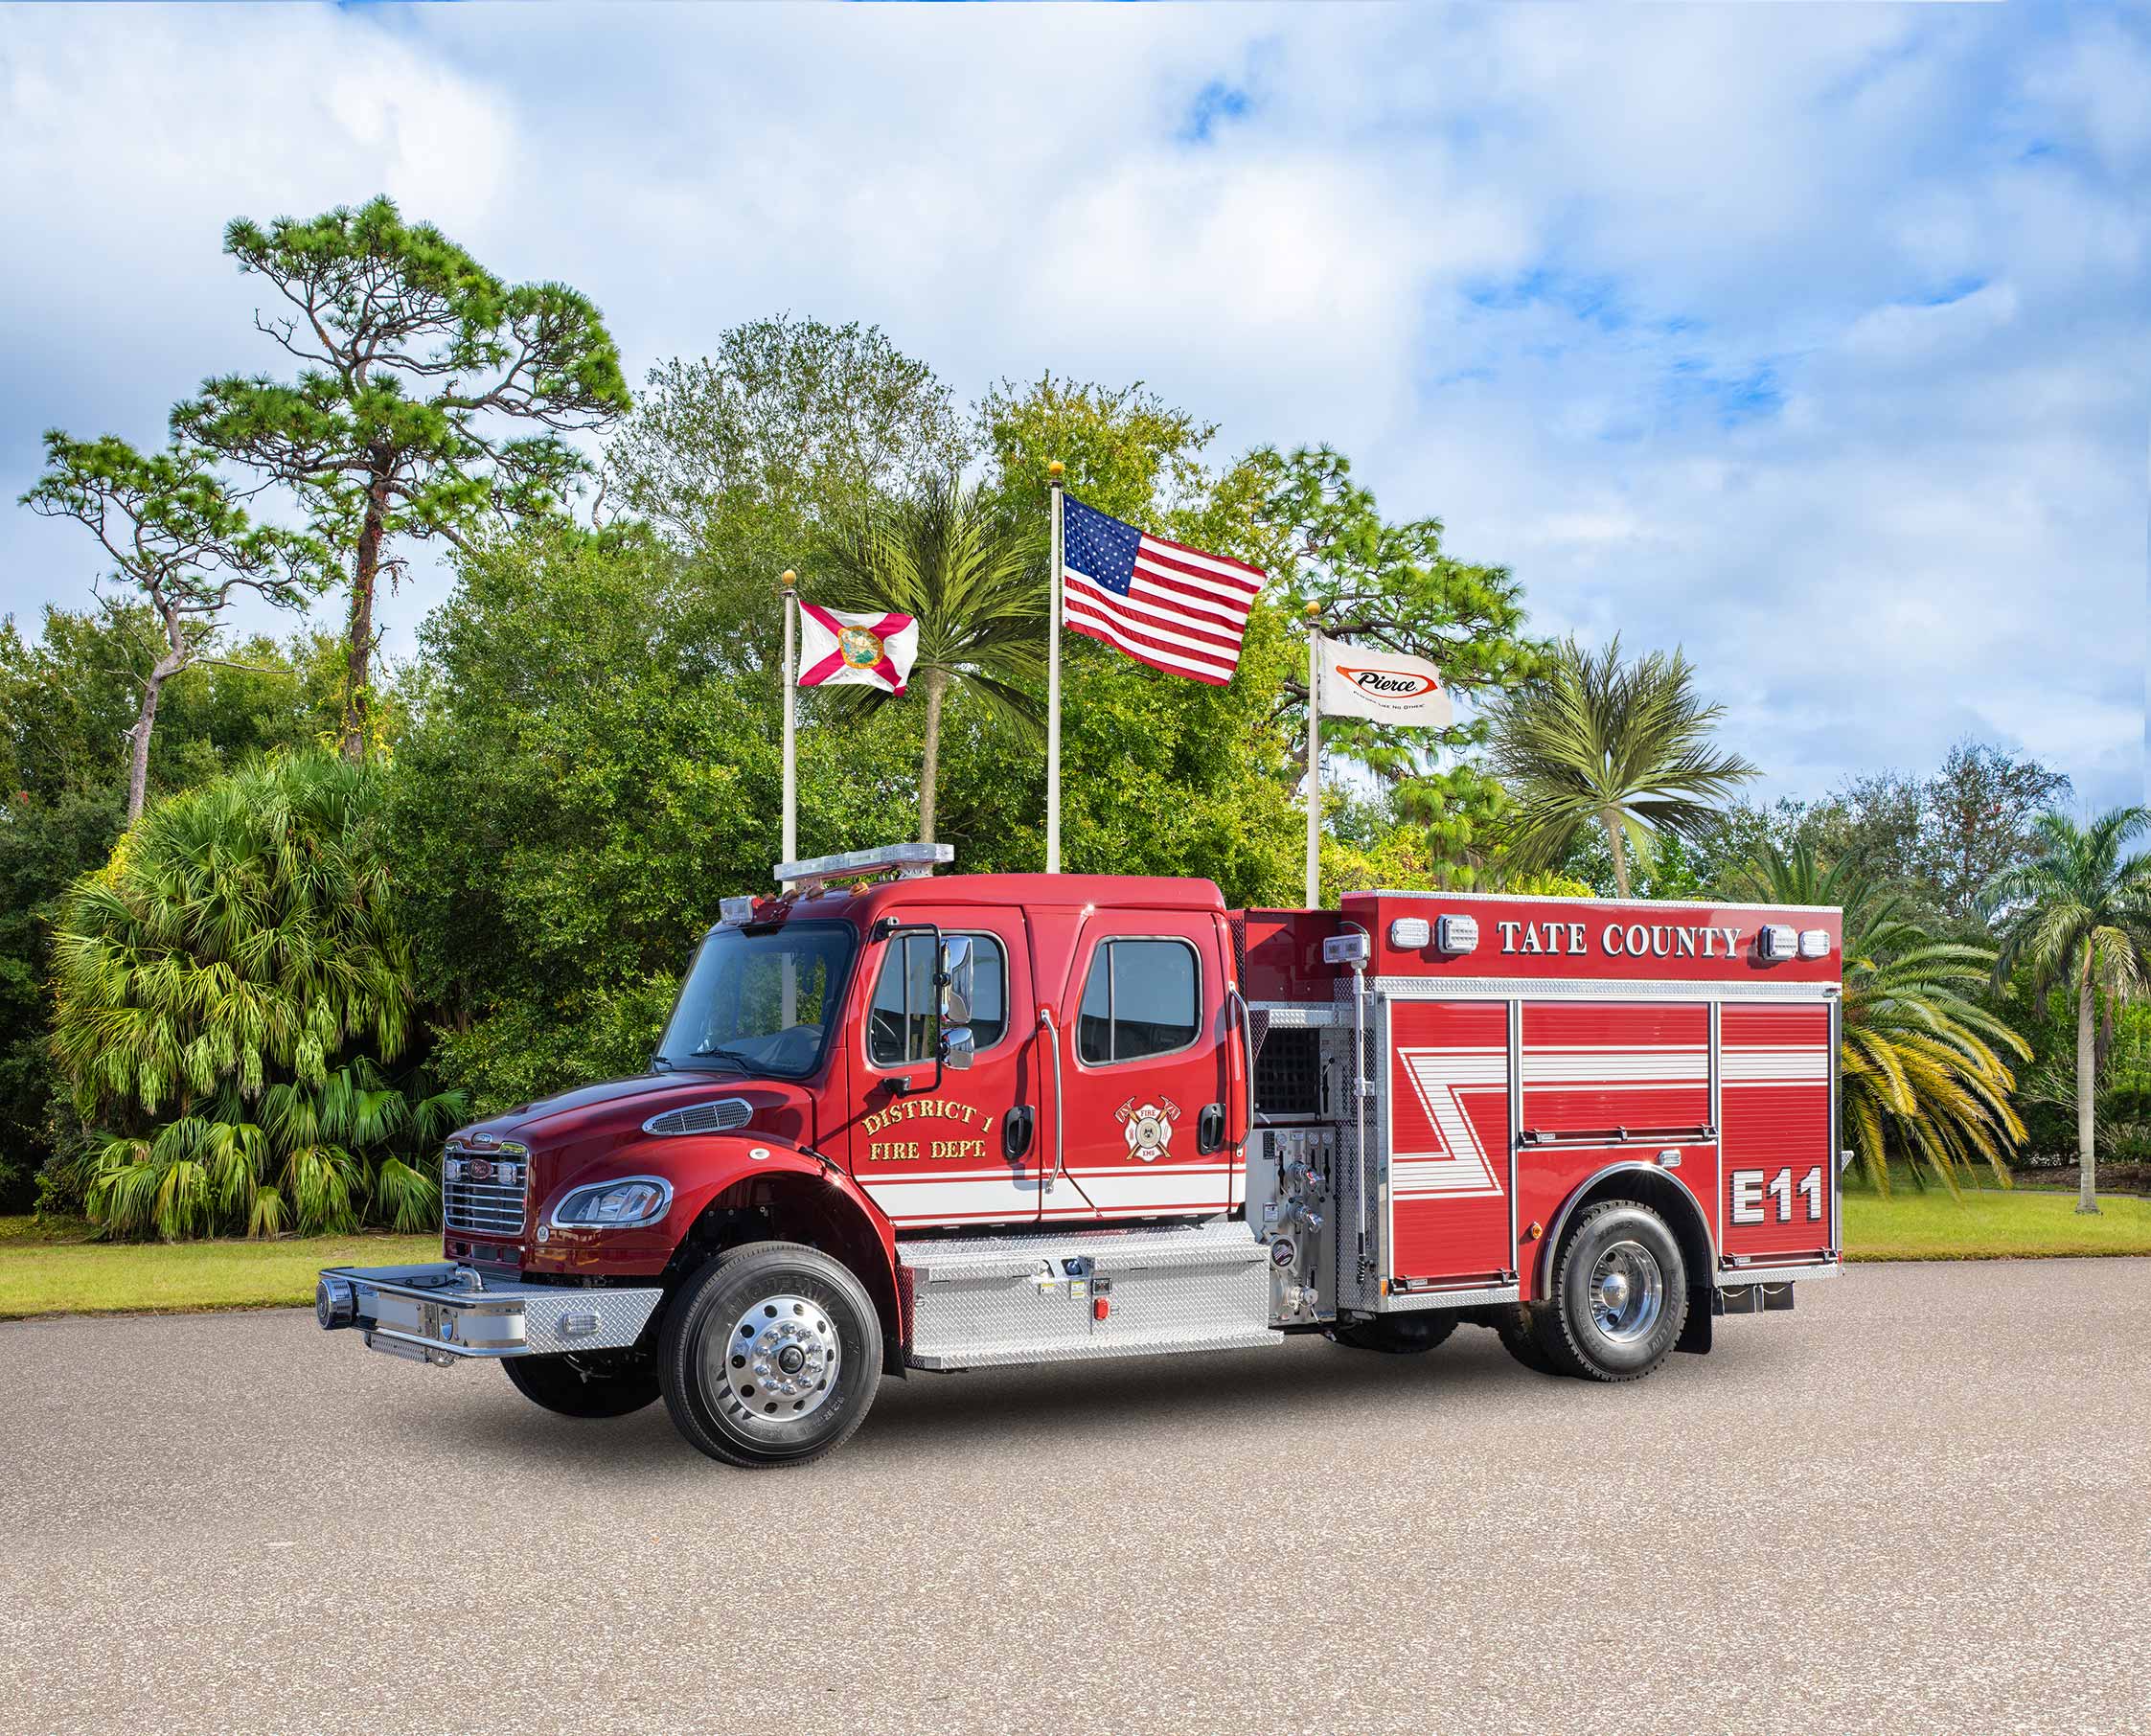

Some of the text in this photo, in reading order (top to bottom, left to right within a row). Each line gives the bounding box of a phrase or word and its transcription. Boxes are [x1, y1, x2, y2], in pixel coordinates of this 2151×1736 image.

[1358, 672, 1416, 693] Pierce
[1497, 921, 1742, 958] TATE COUNTY
[862, 1099, 994, 1136] DISTRICT 1
[869, 1140, 986, 1161] FIRE DEPT.
[1730, 1166, 1821, 1226] E11
